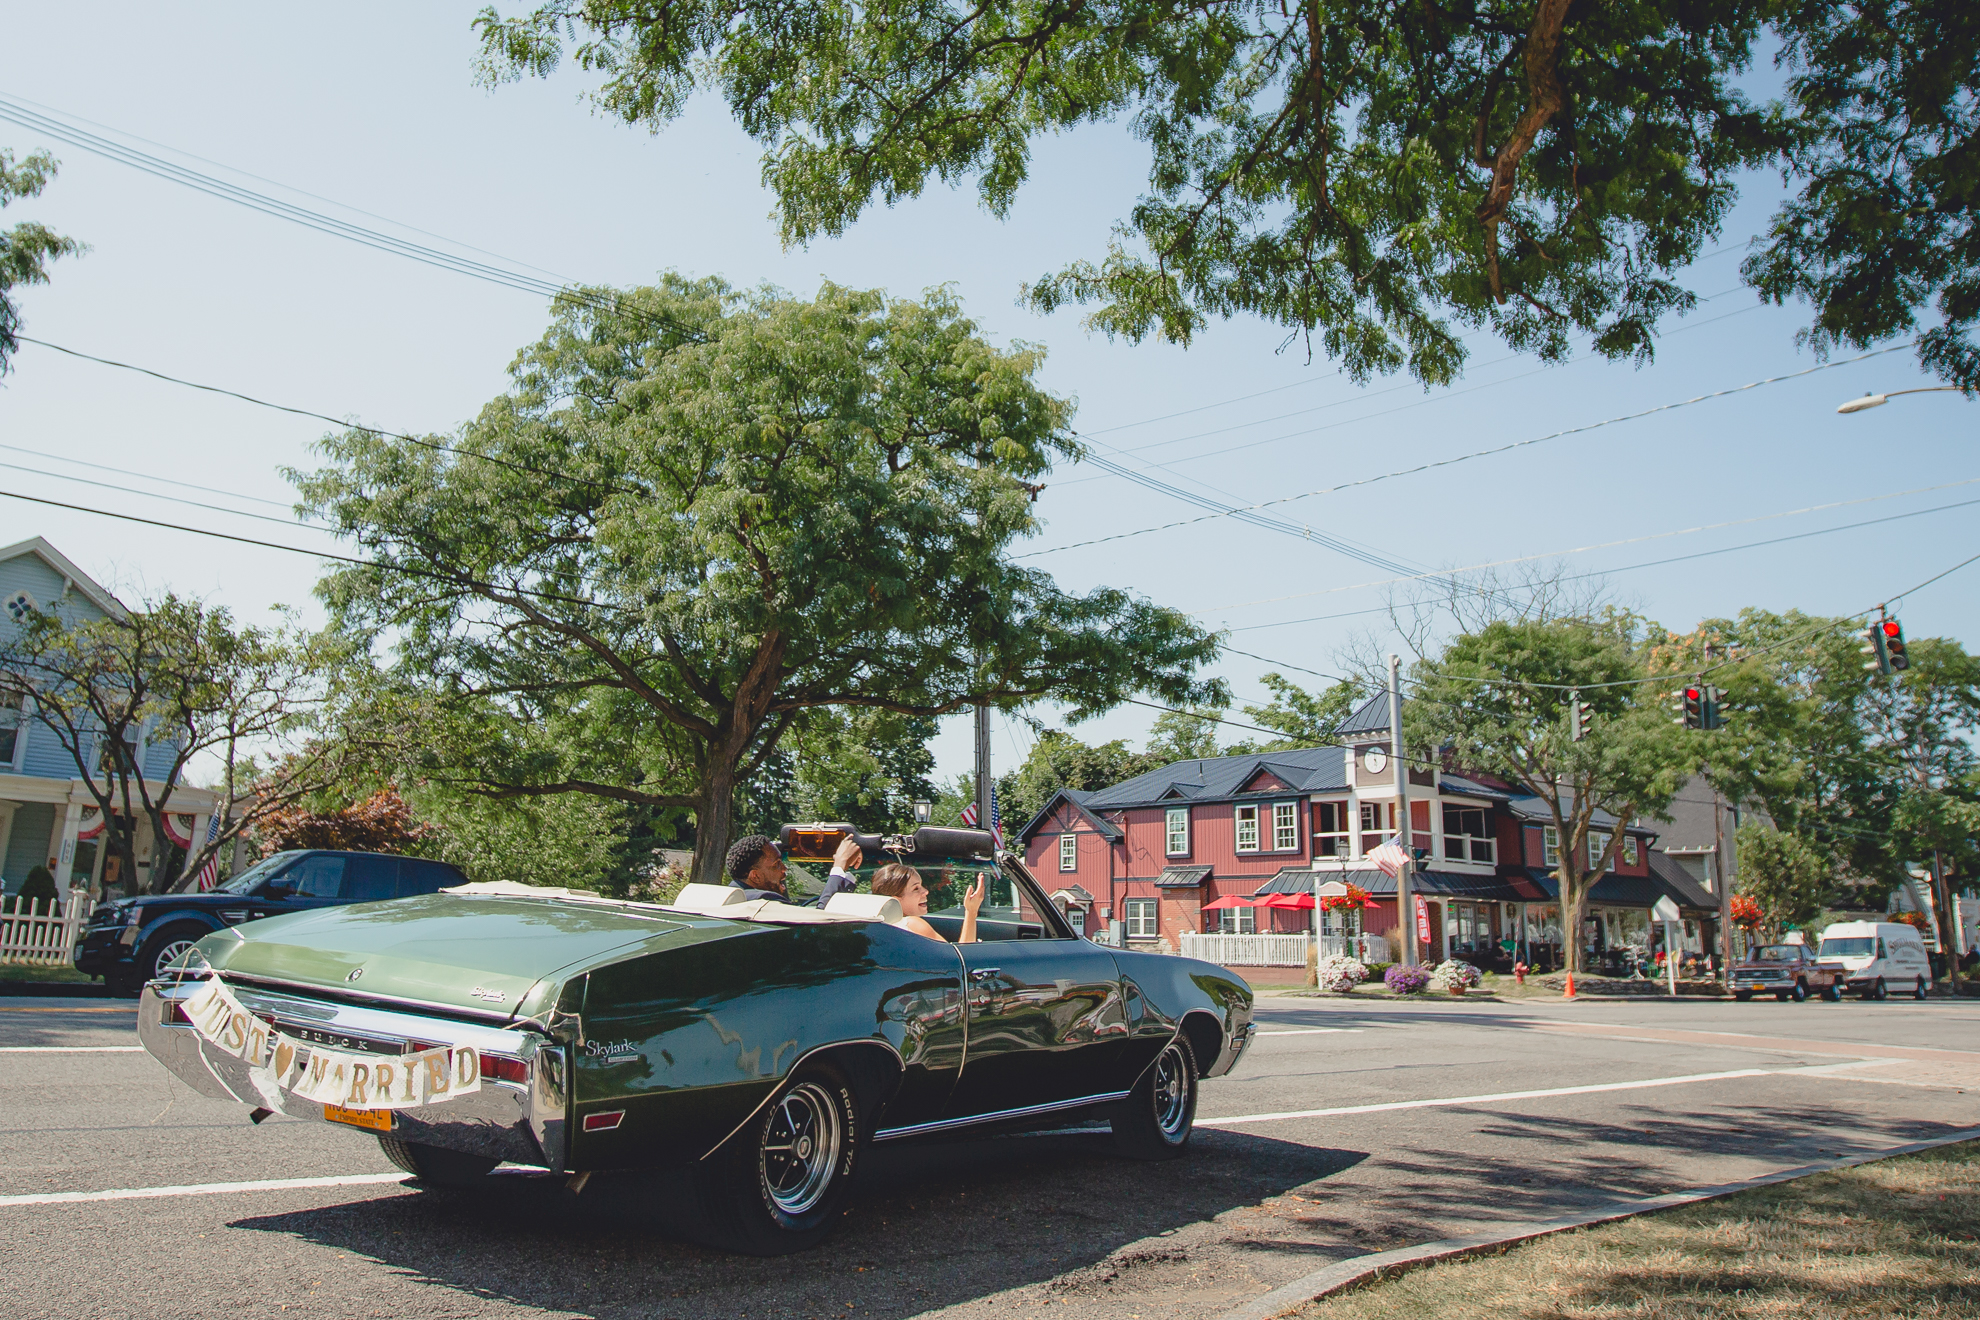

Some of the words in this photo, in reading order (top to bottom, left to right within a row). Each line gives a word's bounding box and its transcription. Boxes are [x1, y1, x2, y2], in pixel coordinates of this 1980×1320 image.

[1418, 898, 1428, 938] OPEN
[189, 988, 265, 1065] JUST
[298, 1047, 478, 1104] MARRIED
[300, 1030, 368, 1050] BUICK
[585, 1038, 638, 1058] Skylark
[359, 1118, 374, 1126] STATE
[840, 1087, 855, 1143] Radial
[842, 1149, 854, 1176] T/A
